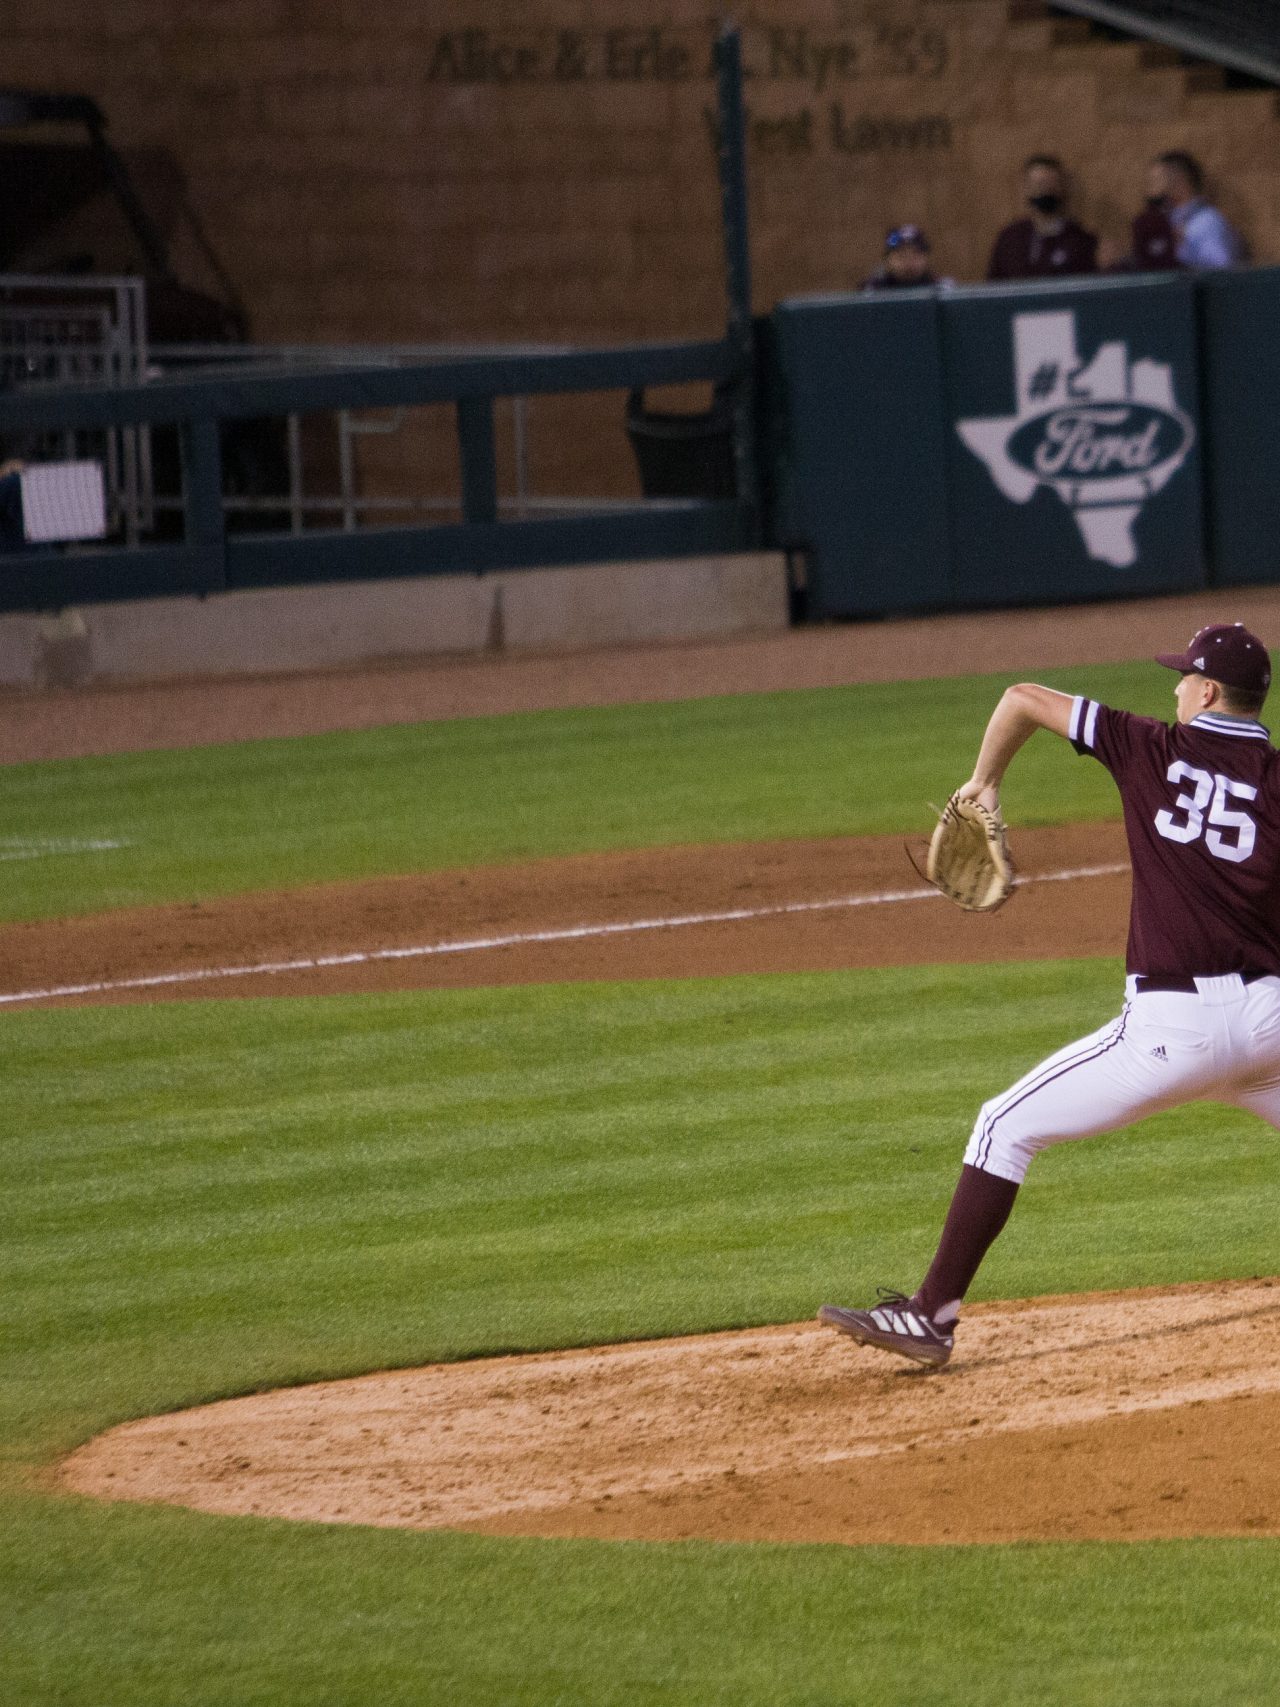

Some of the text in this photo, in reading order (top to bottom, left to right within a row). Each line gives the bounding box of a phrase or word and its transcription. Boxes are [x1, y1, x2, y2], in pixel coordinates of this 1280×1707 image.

[770, 27, 859, 91] Nye
[1035, 409, 1158, 473] Ford
[1154, 760, 1258, 863] 35
